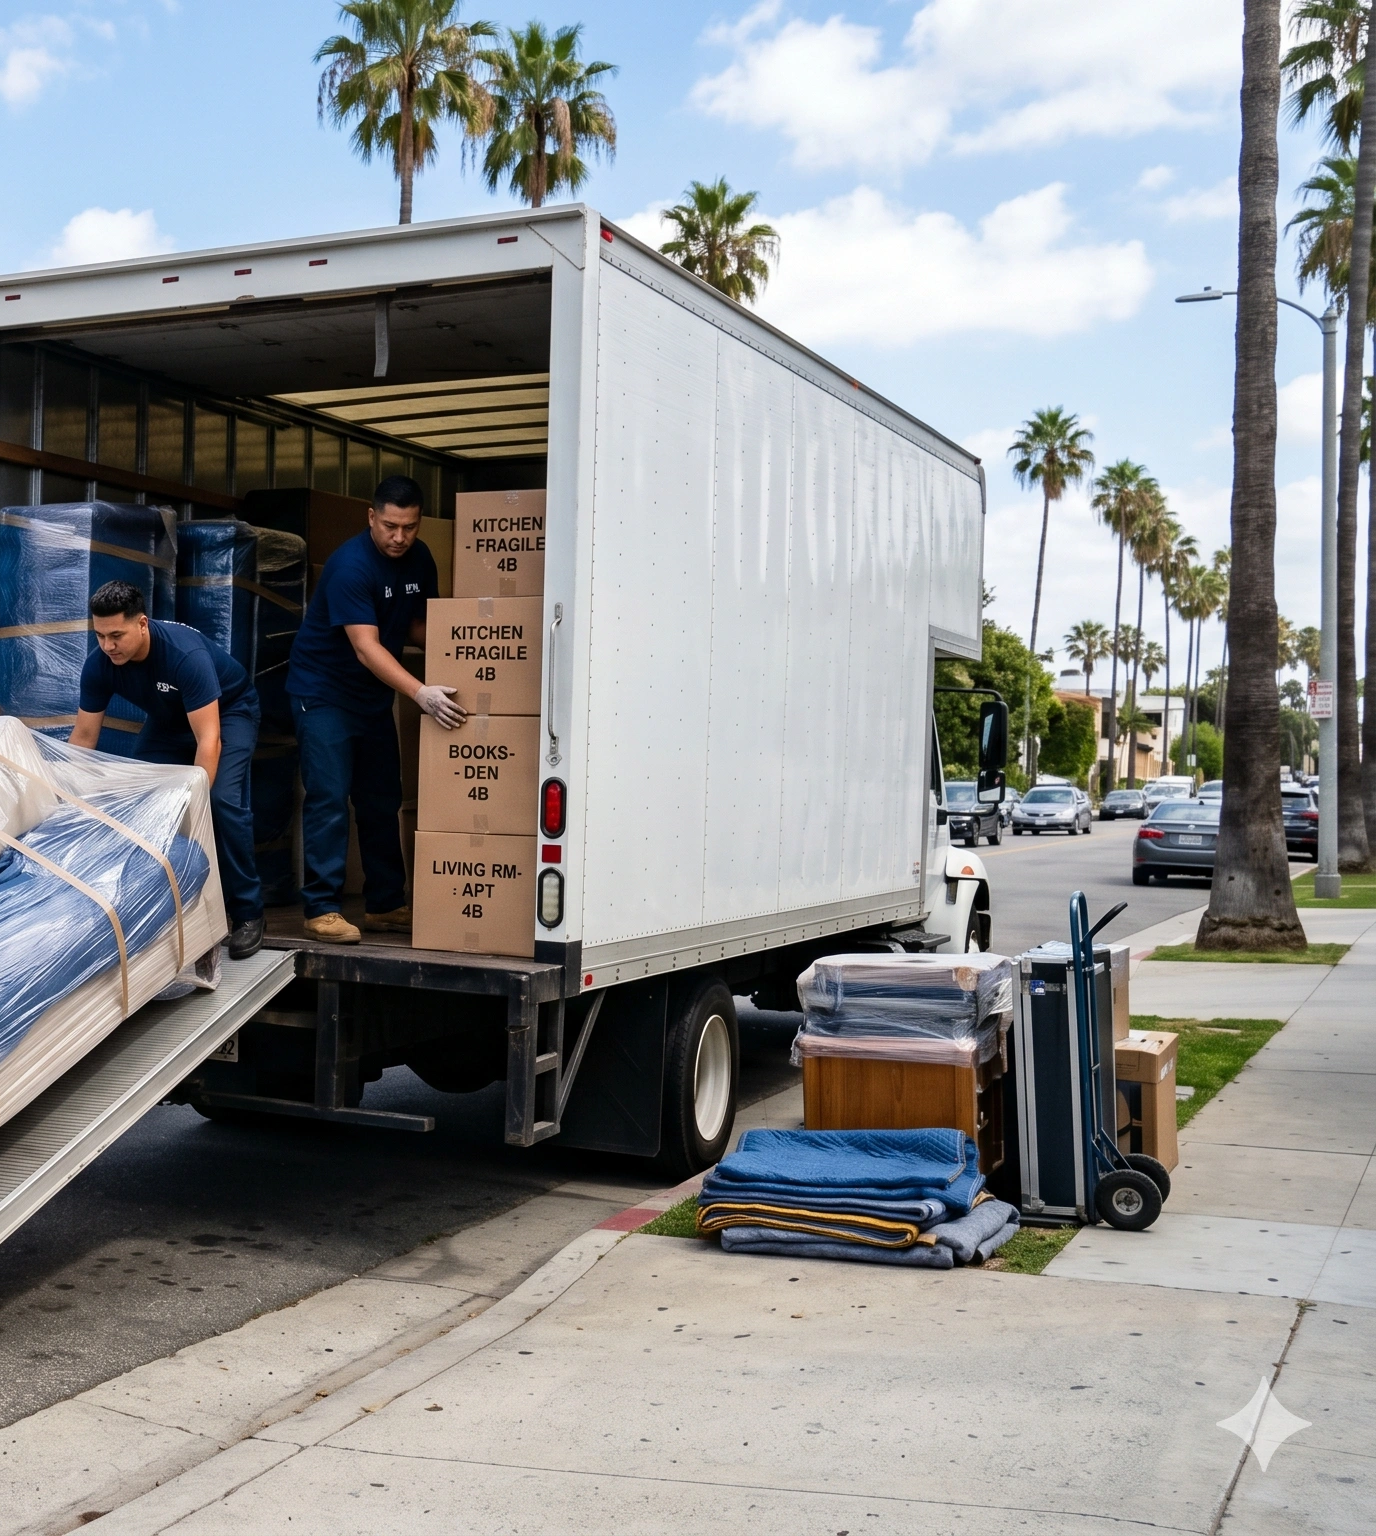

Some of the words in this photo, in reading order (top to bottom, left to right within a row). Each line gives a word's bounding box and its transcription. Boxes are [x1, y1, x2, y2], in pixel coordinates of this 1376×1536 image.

[472, 516, 543, 533] KITCHEN
[476, 536, 545, 553] FRAGILE
[497, 557, 517, 572] 4B
[451, 625, 523, 640] KITCHEN
[455, 645, 527, 660] FRAGILE
[475, 666, 496, 681] 4B
[449, 744, 515, 760] BOOKS-
[464, 765, 498, 780] DEN
[467, 786, 489, 801] 4B
[432, 860, 486, 877] LIVING
[491, 863, 522, 879] RM-
[462, 882, 495, 898] APT
[461, 903, 483, 919] 4B
